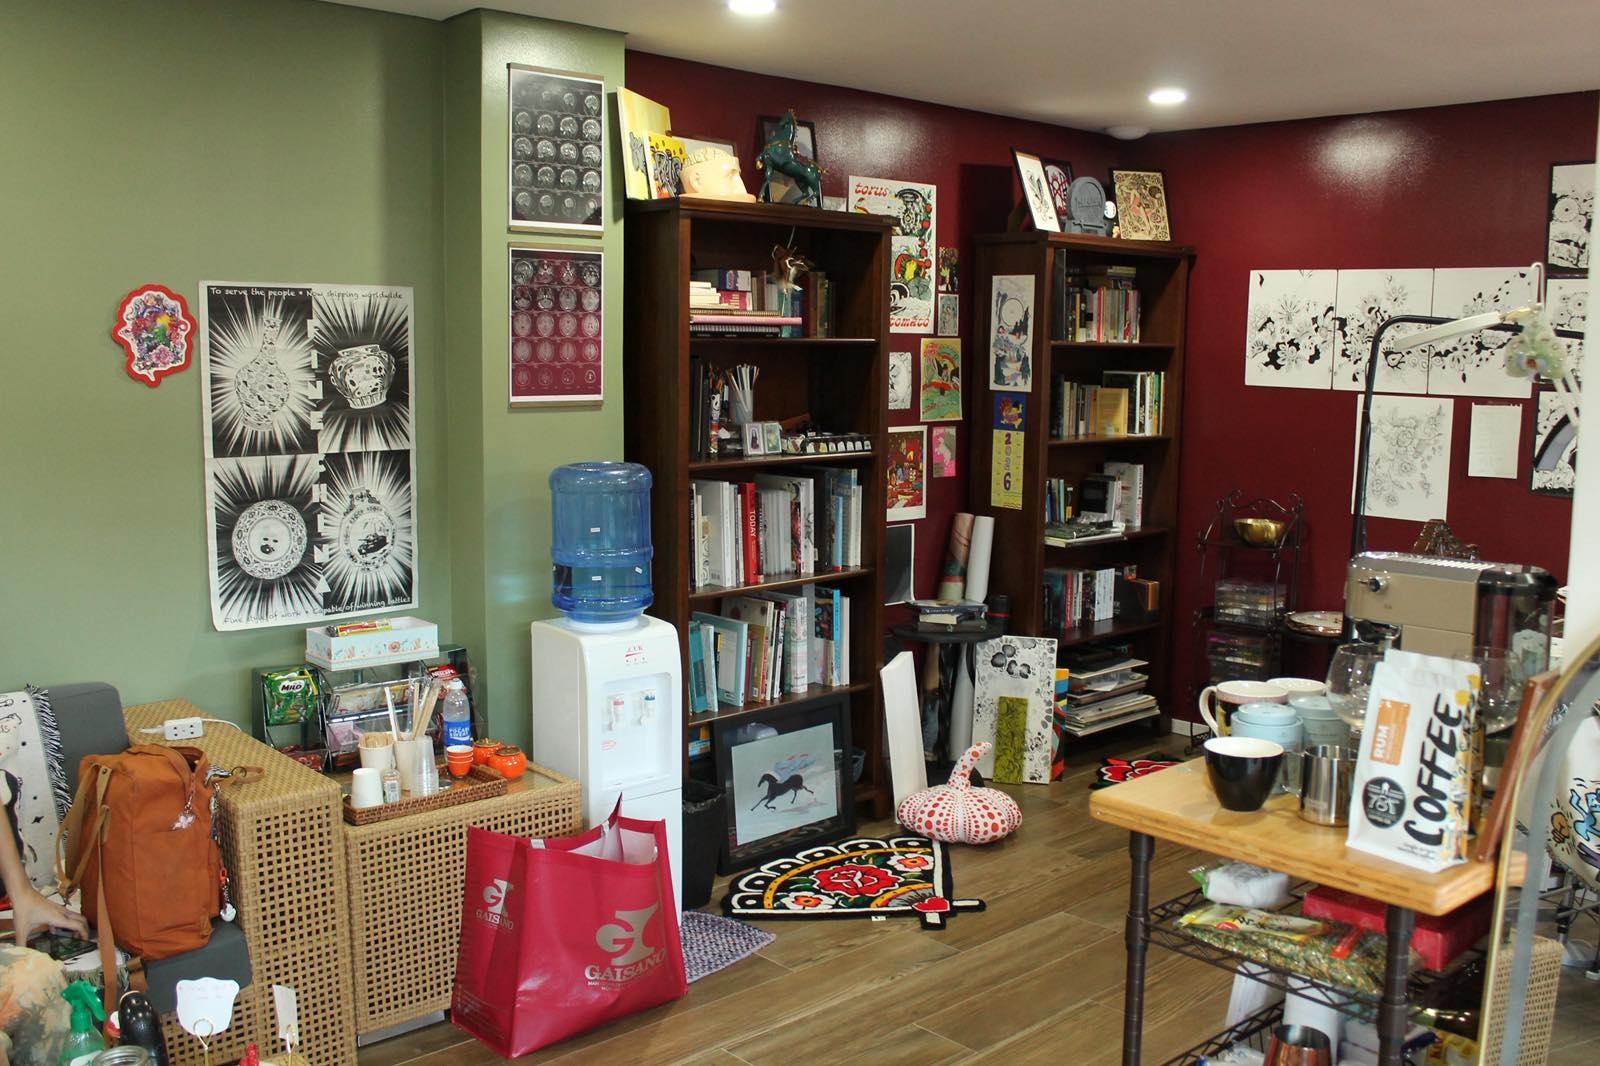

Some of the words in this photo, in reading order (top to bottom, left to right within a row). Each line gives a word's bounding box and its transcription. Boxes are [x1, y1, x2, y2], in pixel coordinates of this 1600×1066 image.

[854, 182, 888, 197] torus
[210, 287, 221, 295] To
[251, 288, 264, 296] the
[268, 289, 295, 300] people
[327, 290, 358, 300] shipping
[362, 291, 402, 299] worldwide
[282, 610, 301, 619] work
[313, 605, 342, 616] Capable
[356, 599, 386, 609] winning
[281, 683, 302, 691] MILO
[1375, 725, 1389, 758] RUM
[1403, 693, 1463, 846] COFFEE
[475, 909, 514, 930] GAISANO
[584, 949, 666, 981] GAISANO
